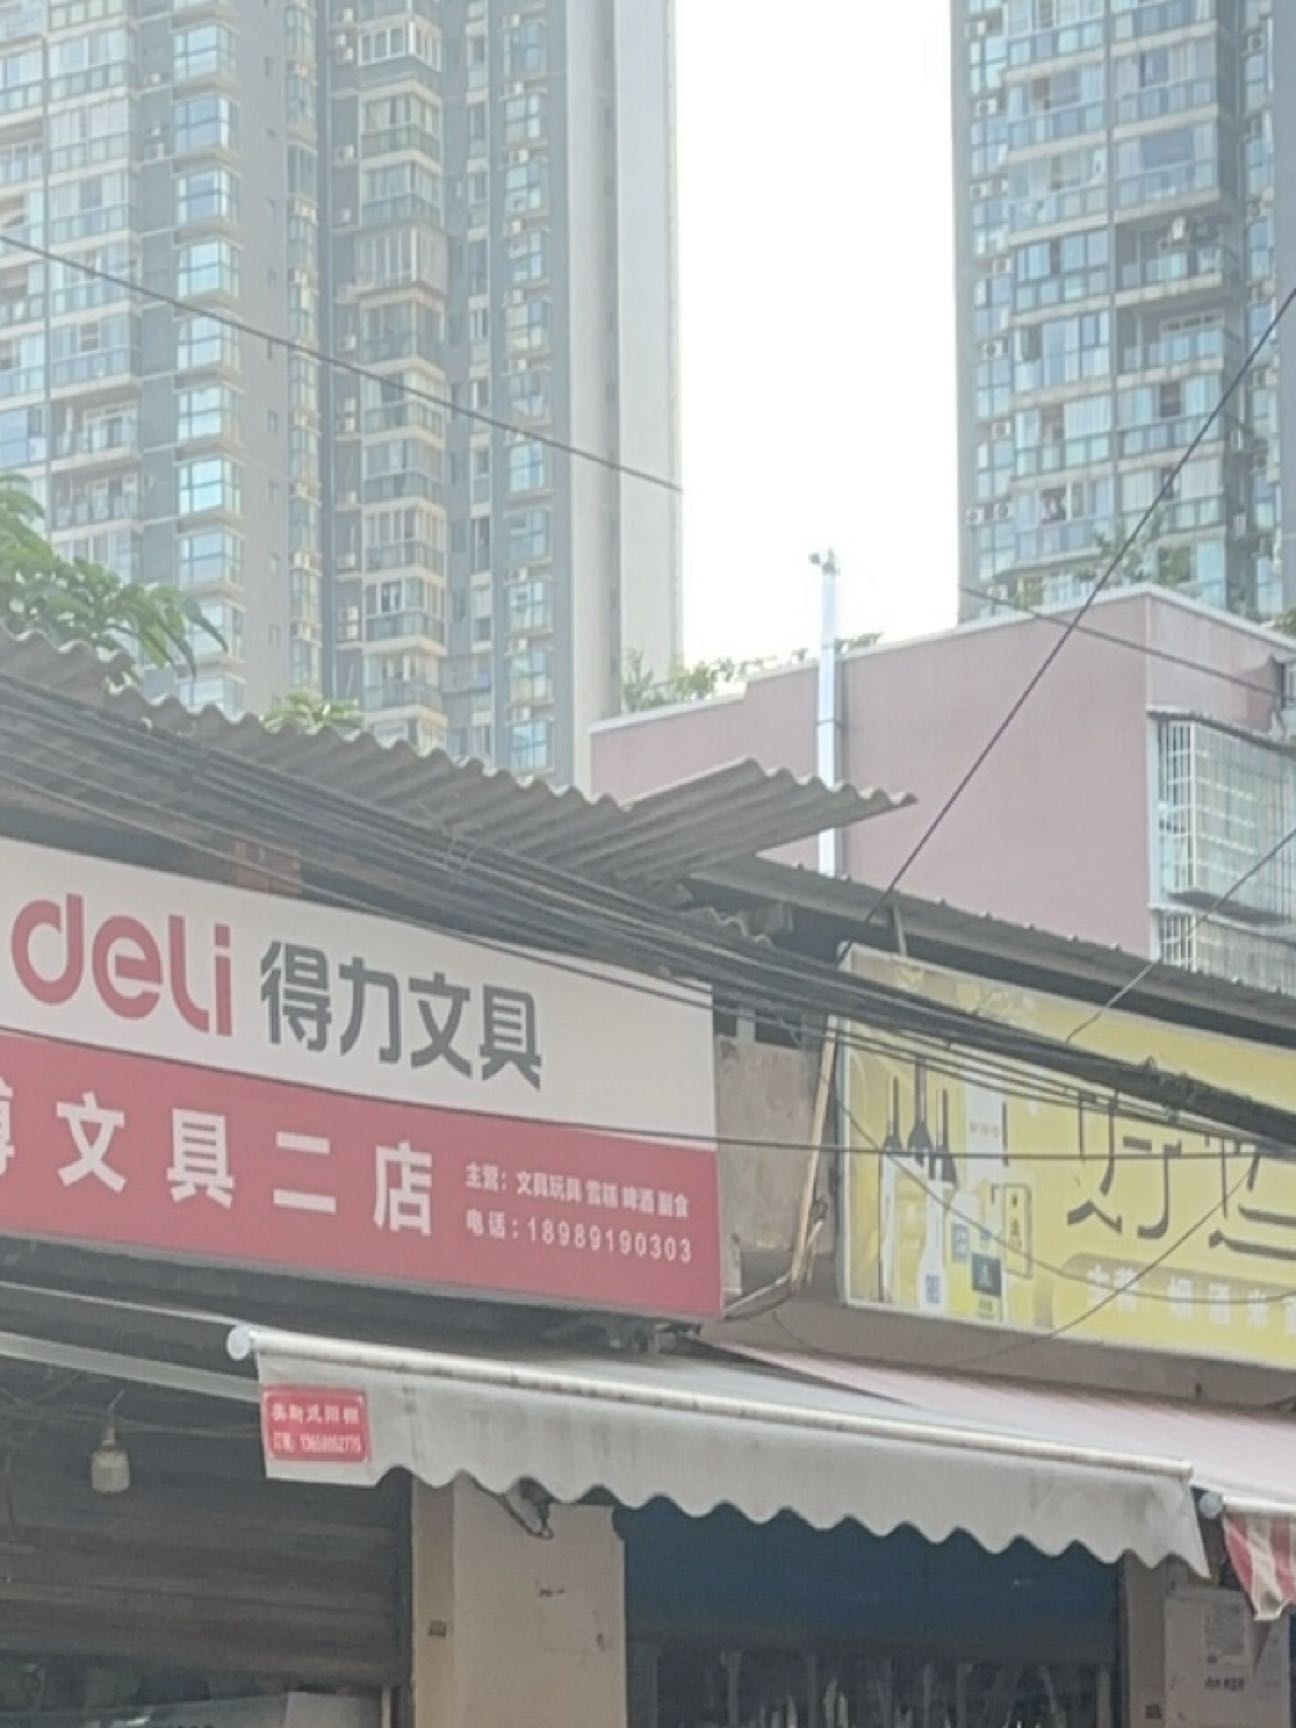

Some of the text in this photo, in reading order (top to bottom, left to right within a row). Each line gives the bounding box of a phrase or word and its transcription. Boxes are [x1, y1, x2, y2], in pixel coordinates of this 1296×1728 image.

[11, 893, 542, 1091] deli 得力文具
